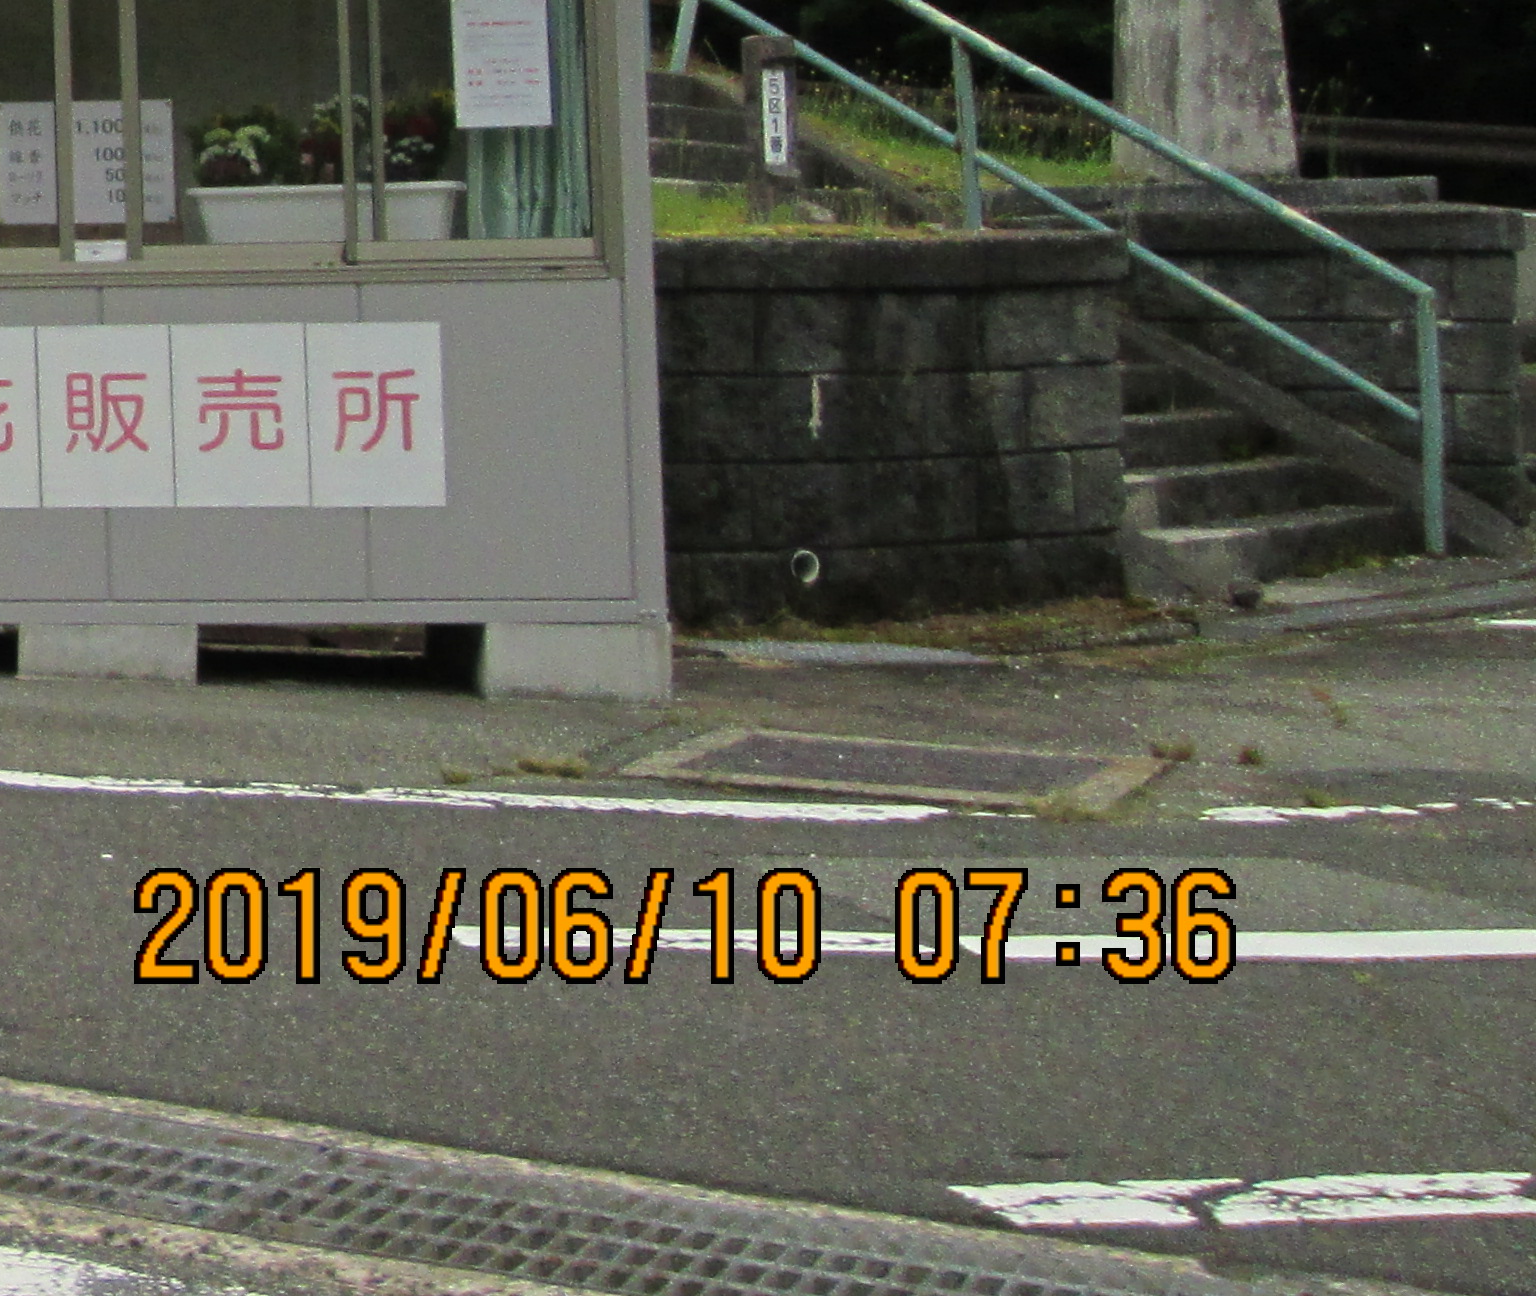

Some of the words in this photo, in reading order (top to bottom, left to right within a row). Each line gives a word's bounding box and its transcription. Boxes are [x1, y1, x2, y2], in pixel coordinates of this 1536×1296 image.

[9, 119, 42, 137] 供花
[96, 147, 125, 162] 100
[105, 168, 125, 183] 50
[108, 189, 127, 204] 10
